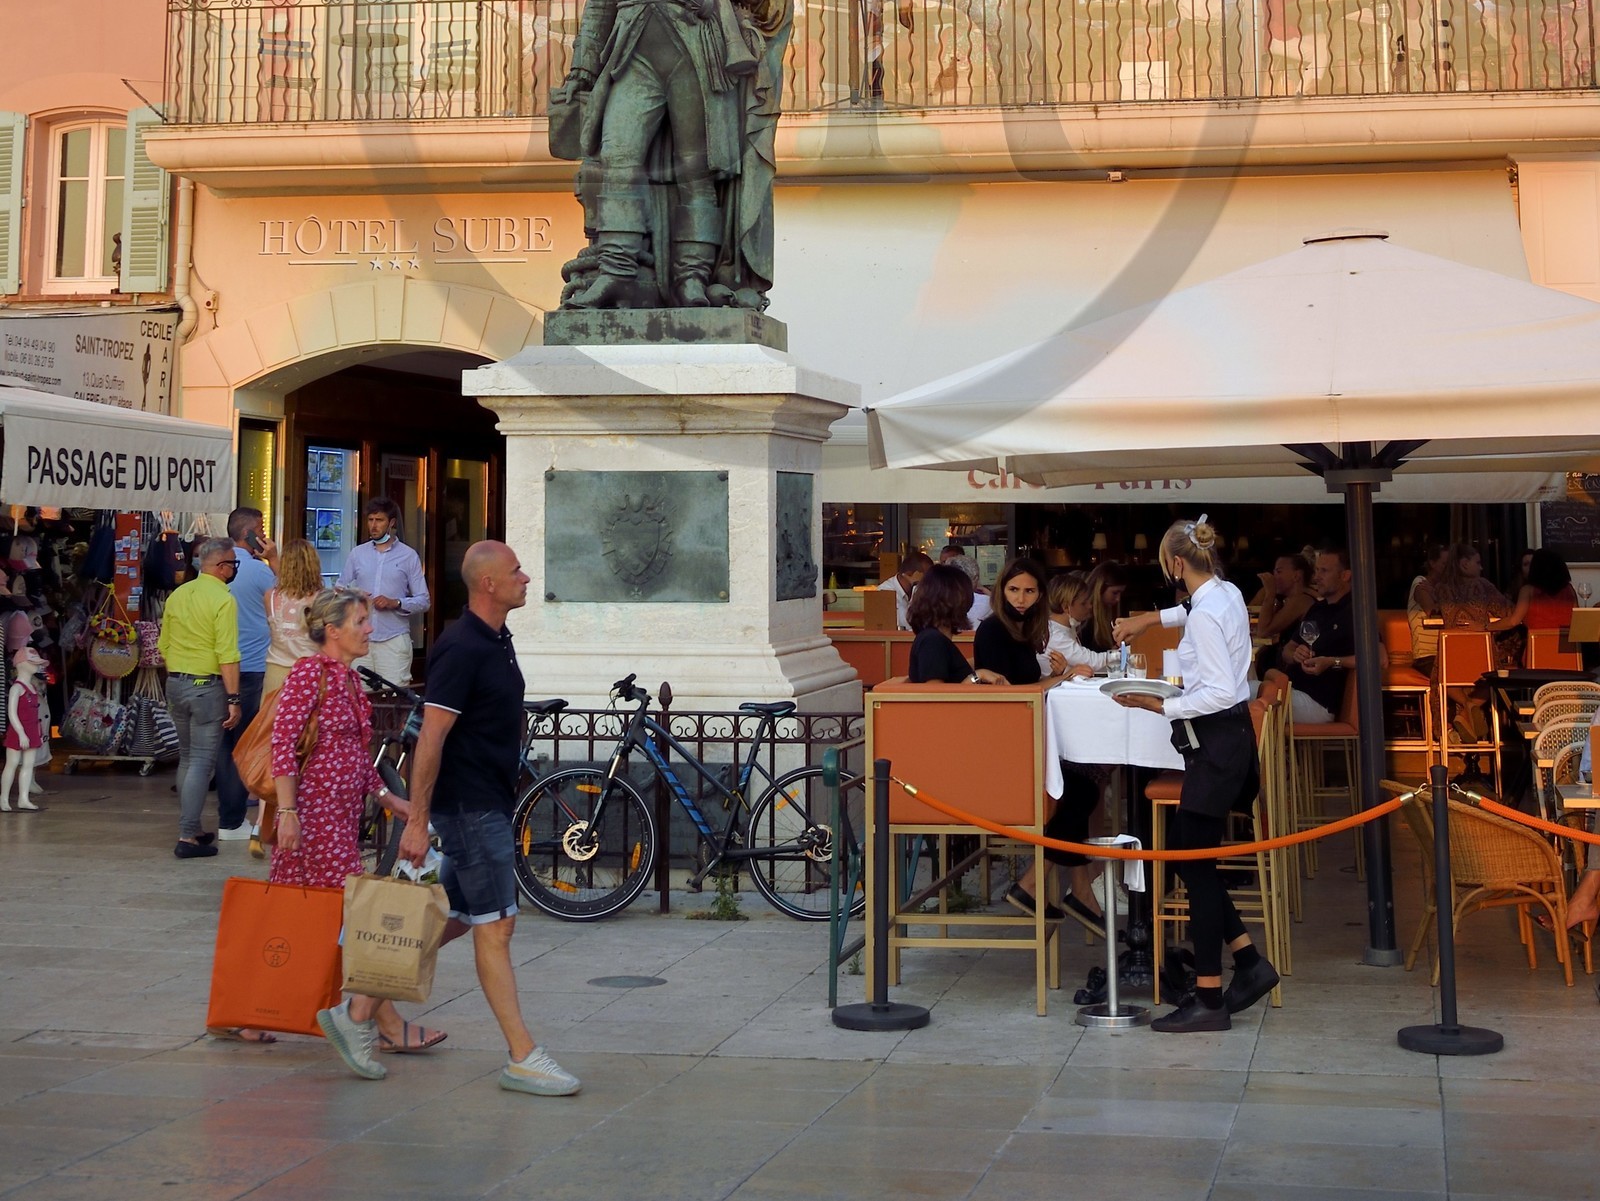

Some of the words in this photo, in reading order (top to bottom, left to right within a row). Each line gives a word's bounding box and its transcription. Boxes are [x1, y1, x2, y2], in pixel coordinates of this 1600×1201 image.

[258, 215, 418, 255] HÔTEL
[432, 216, 554, 253] SUBE
[75, 333, 135, 361] SAINT-TROPEZ
[27, 445, 127, 490] PASSAGE
[134, 455, 161, 491] DU
[167, 456, 217, 493] PORT
[355, 929, 424, 950] TOGETHER
